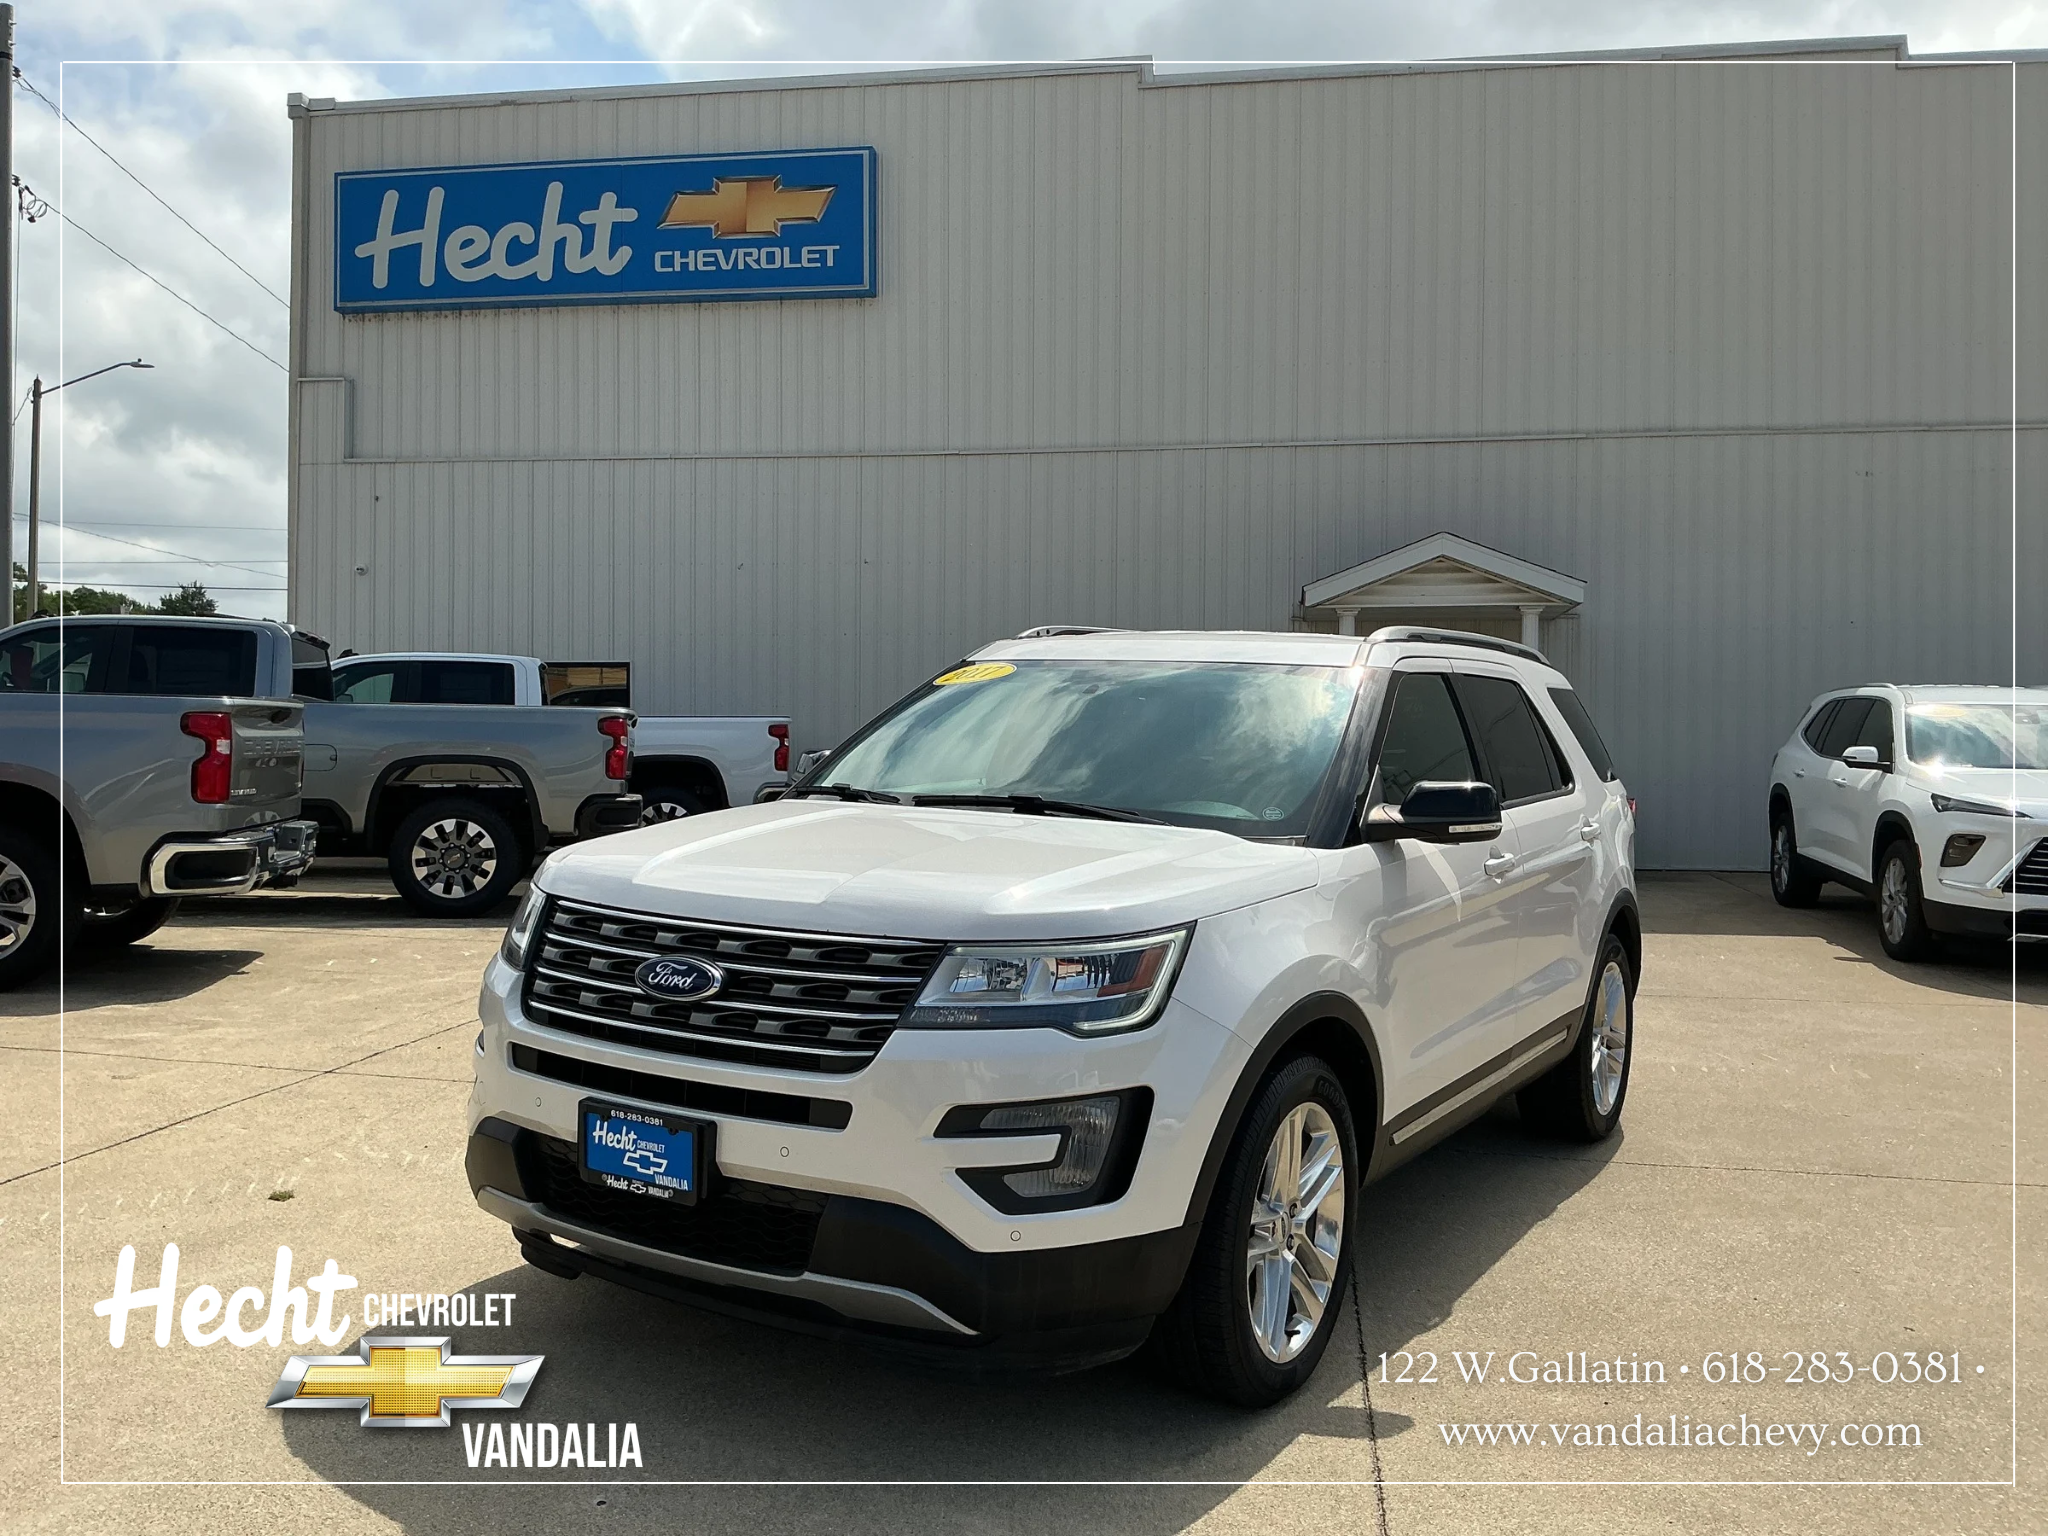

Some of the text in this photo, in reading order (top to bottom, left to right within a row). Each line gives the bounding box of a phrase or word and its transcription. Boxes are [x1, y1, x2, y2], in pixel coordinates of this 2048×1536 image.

[355, 181, 638, 289] Hecht
[654, 244, 840, 273] CHEVROLET
[648, 962, 698, 989] Ford
[610, 1110, 664, 1127] 618-283-0381
[593, 1120, 666, 1154] Hecht CHEVROLET
[606, 1174, 629, 1191] Hecht
[654, 1173, 689, 1192] VANDALIA
